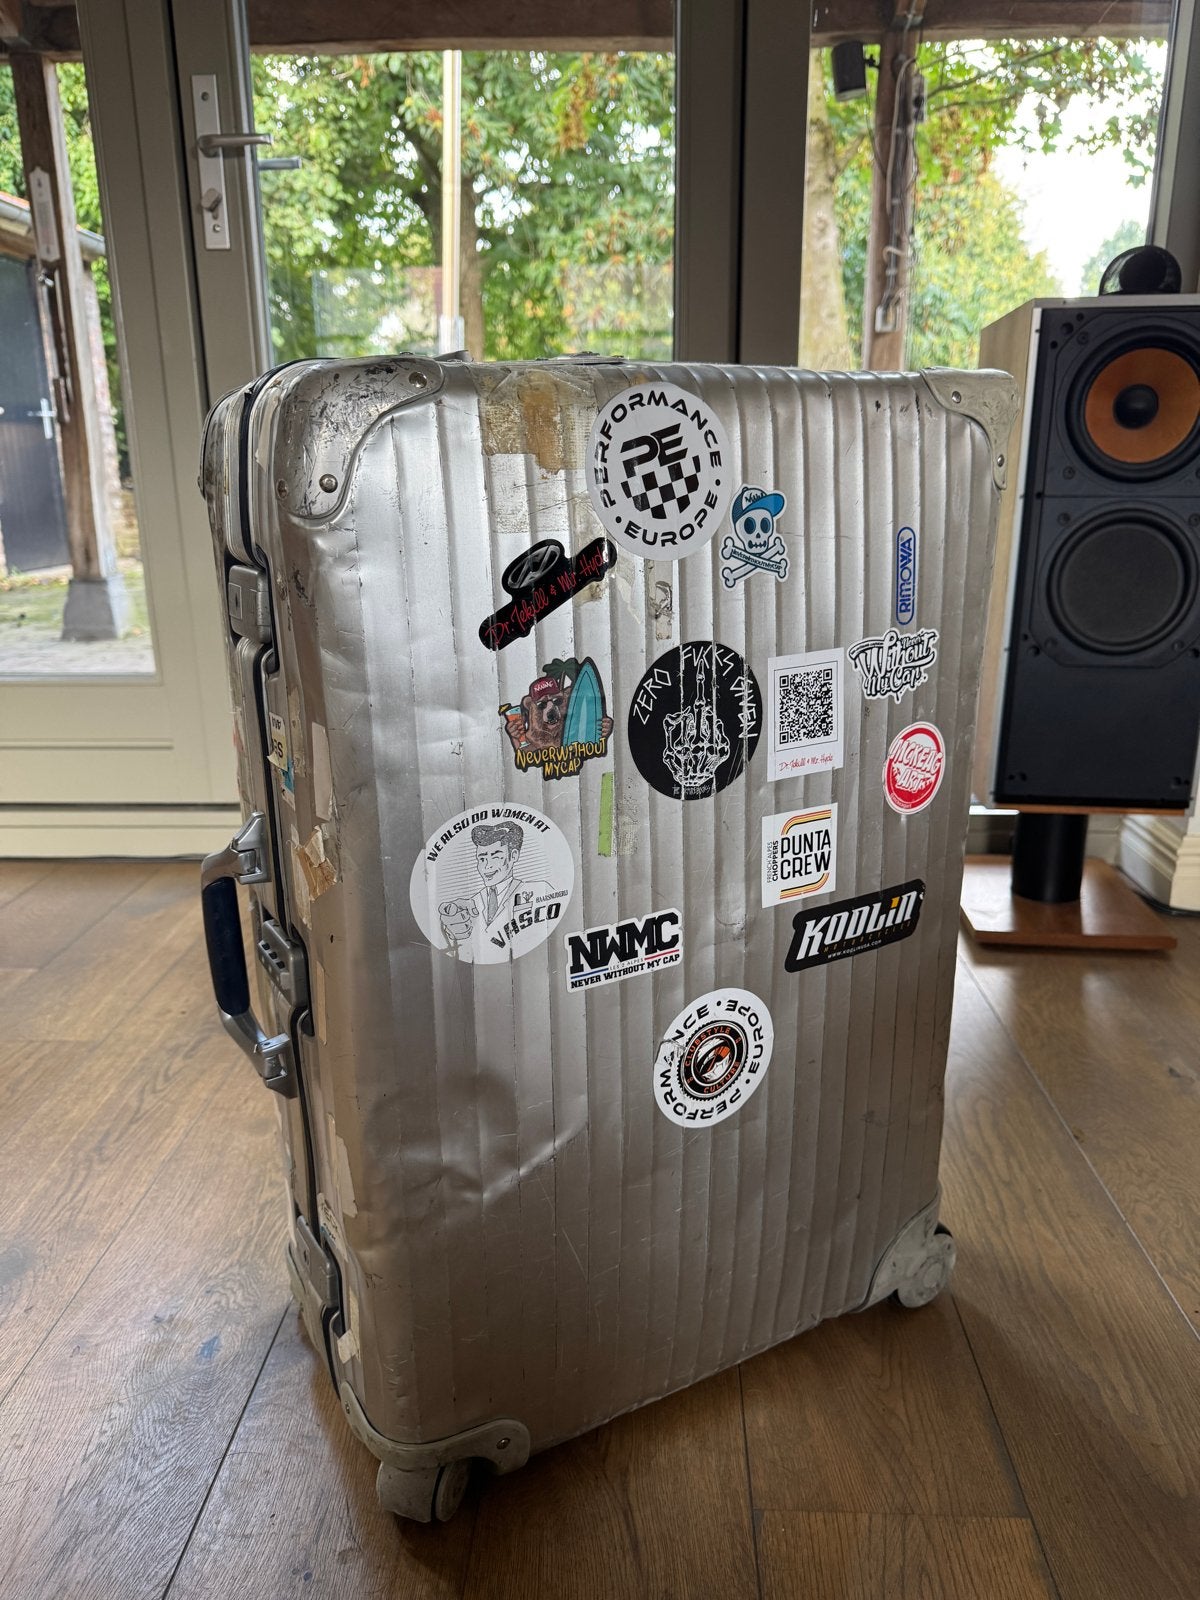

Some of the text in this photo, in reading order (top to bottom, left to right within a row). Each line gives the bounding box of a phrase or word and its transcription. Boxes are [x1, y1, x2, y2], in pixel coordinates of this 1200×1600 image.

[594, 390, 722, 508] PERFORMANCE
[620, 422, 689, 479] PE
[624, 490, 718, 547] EUROPE
[550, 584, 557, 596] &
[899, 537, 913, 613] RIMOWA
[633, 668, 672, 725] ZERO
[729, 676, 758, 739] GIVEN
[427, 808, 551, 862] WE ALSO DO WOMEN AT
[780, 829, 831, 859] PUNTA
[780, 850, 831, 880] CREW
[490, 902, 562, 949] VASCO
[568, 912, 680, 975] NWMC
[570, 953, 680, 989] NEVER WITHOUT MY CAP
[725, 999, 764, 1074] EUROPE
